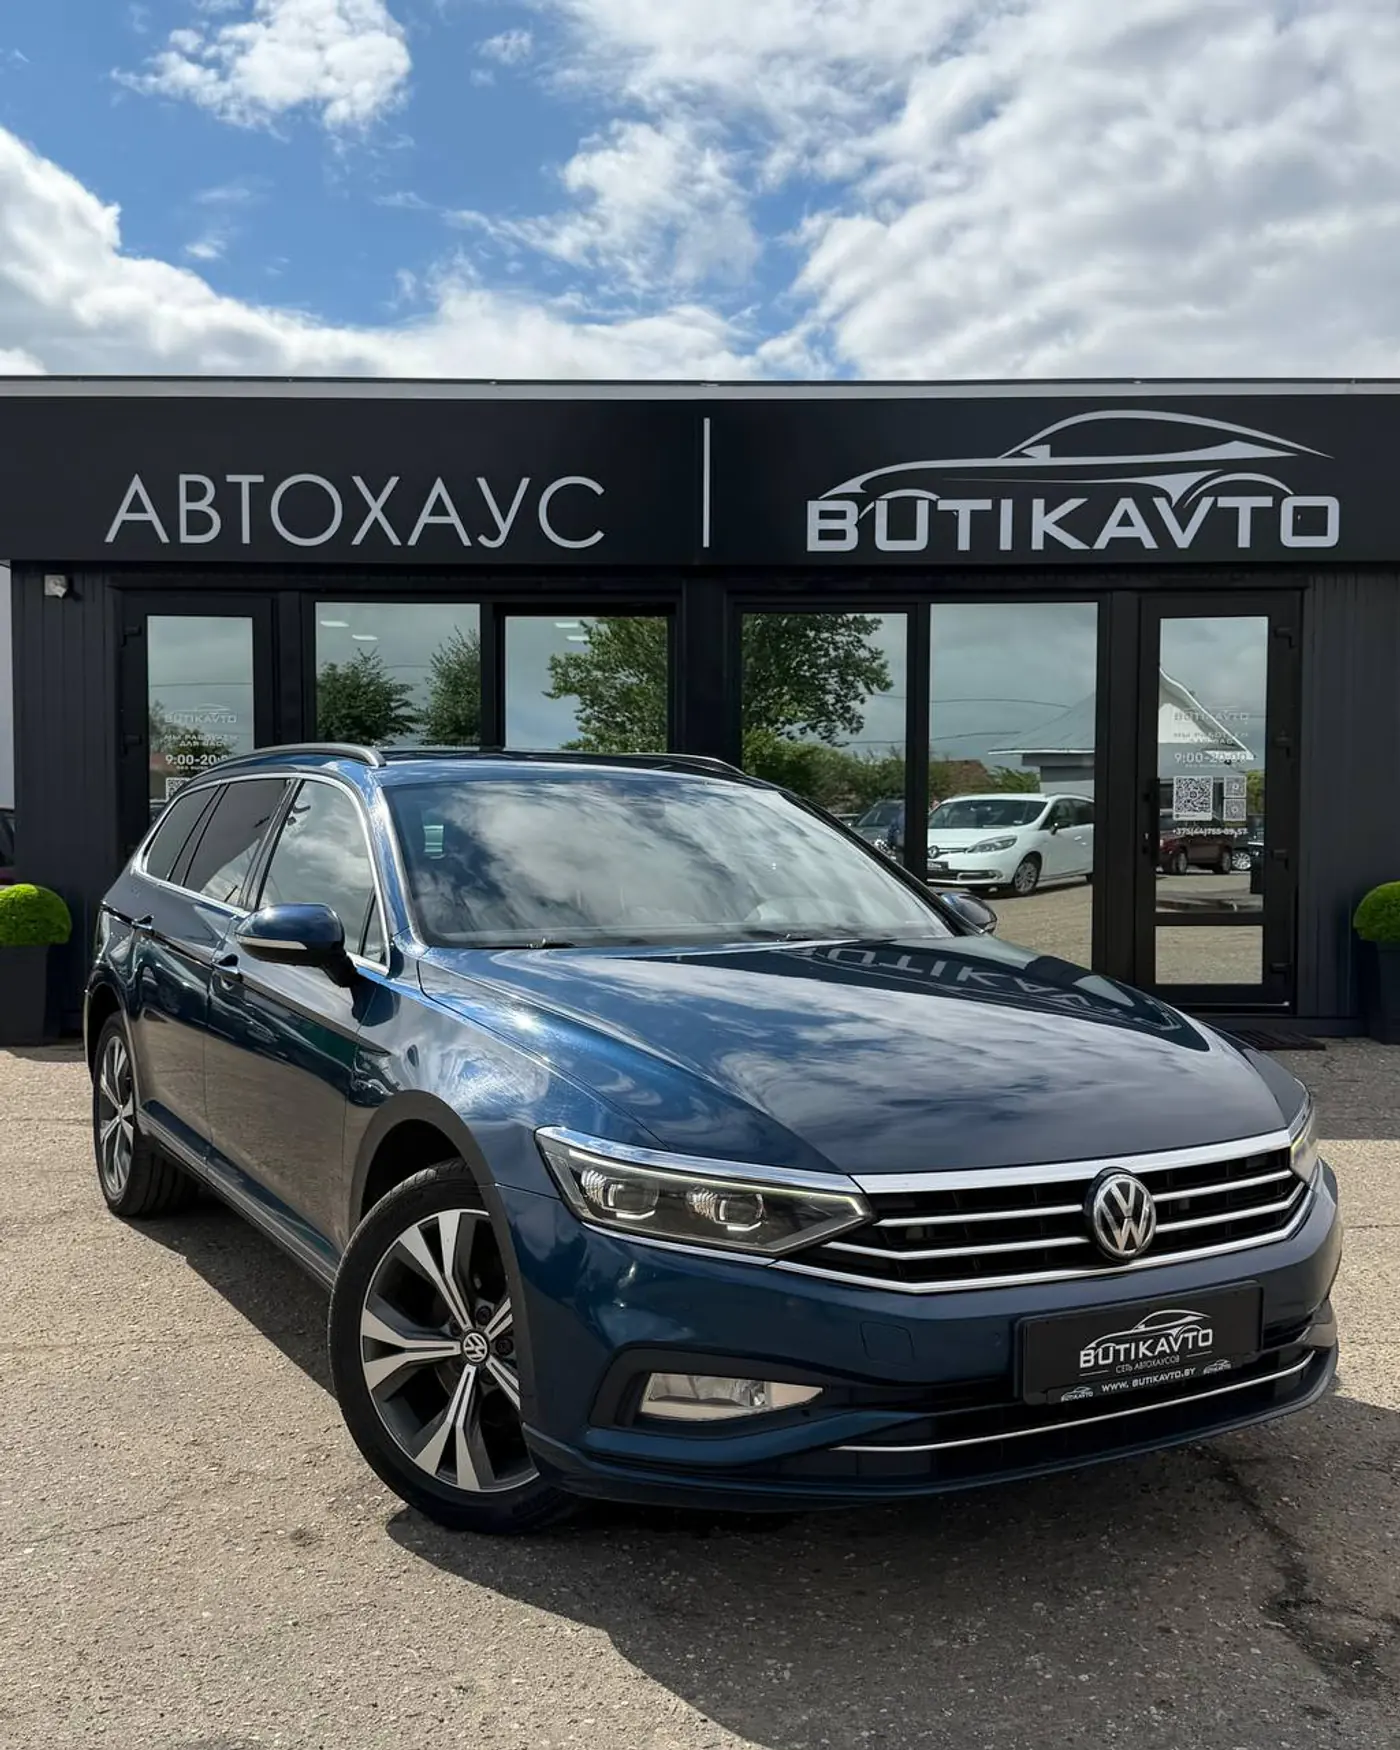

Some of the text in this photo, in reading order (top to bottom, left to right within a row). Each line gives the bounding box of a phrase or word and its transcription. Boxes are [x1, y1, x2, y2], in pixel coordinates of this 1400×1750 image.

[105, 474, 605, 549] АВТОХАУС
[806, 495, 1340, 552] BUTIKAVTO
[165, 754, 228, 766] 9:00-20:
[1080, 1328, 1213, 1368] BUTIKAVTO
[1132, 1367, 1196, 1387] BUTIKAVTO.BY
